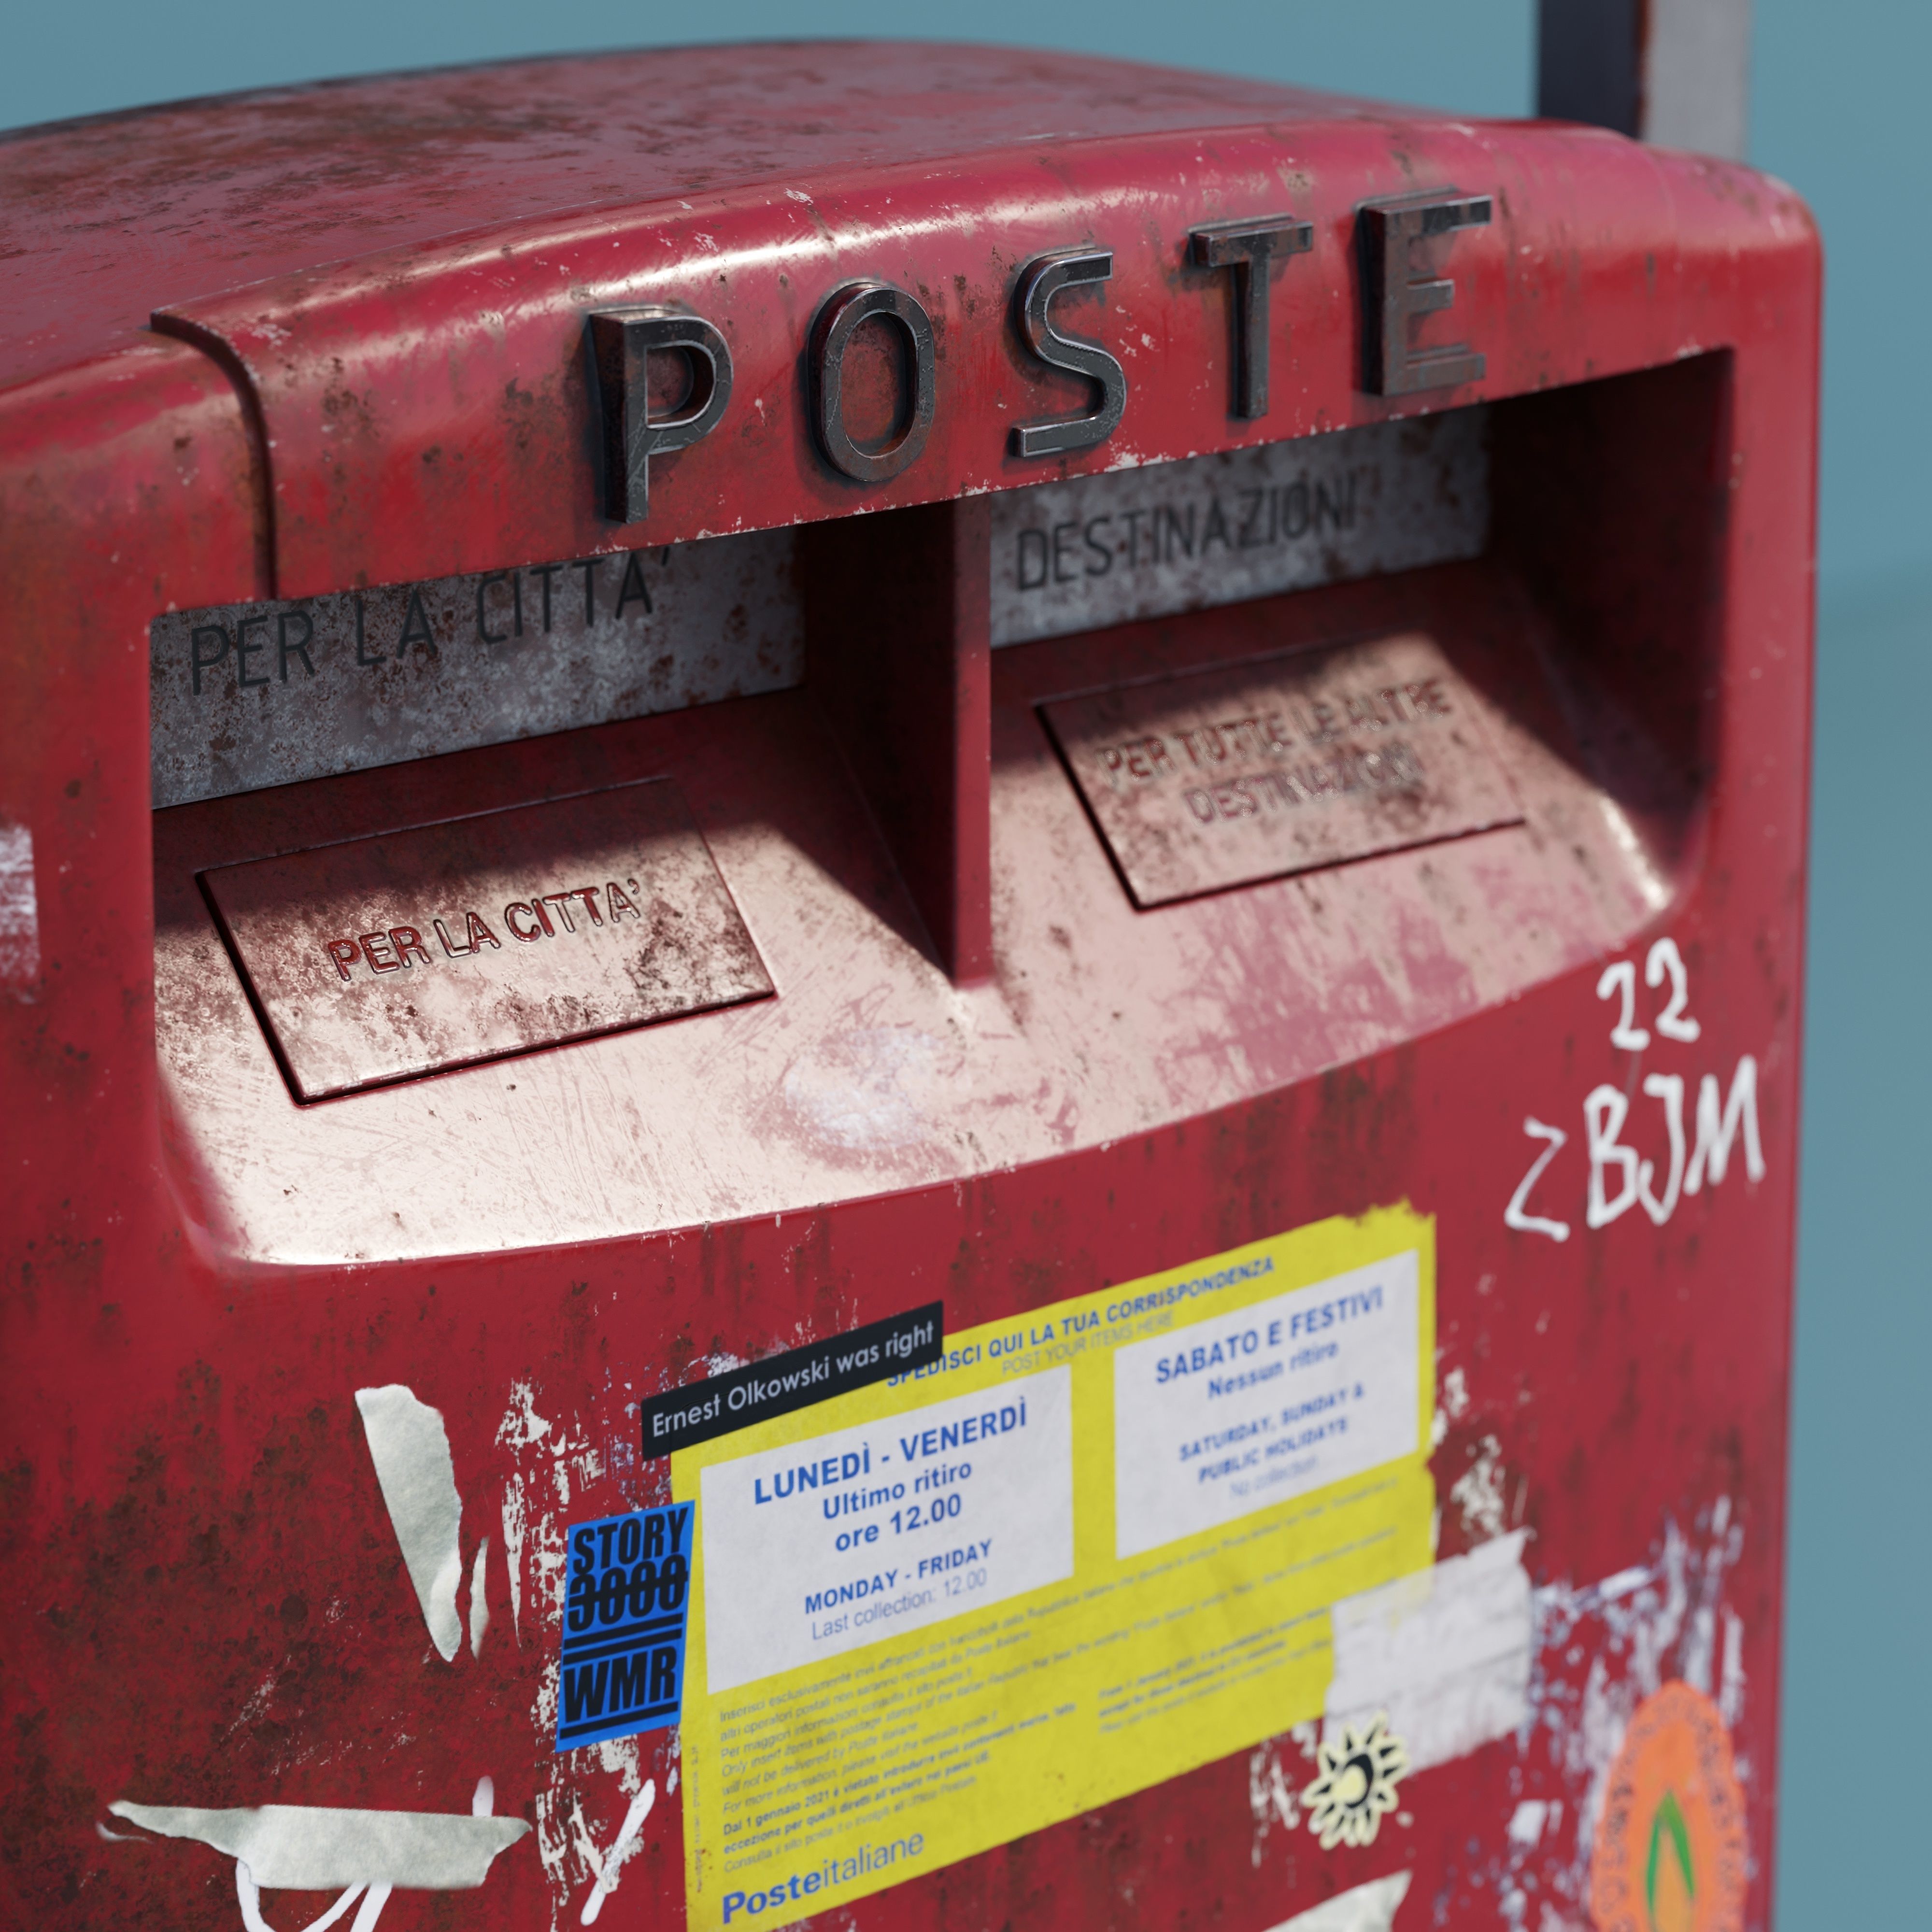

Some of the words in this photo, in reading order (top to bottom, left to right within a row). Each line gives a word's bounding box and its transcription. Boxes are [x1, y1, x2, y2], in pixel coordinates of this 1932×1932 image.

[587, 191, 1492, 524] POSTE
[1017, 471, 1357, 591] DESTINAZIONI
[192, 610, 316, 696] PER
[356, 590, 437, 666] LA
[1098, 739, 1176, 791] PER
[1176, 711, 1292, 765] TUTTE
[1293, 702, 1338, 744] LE
[1350, 679, 1451, 735] ALTRE
[1184, 741, 1424, 826] DESTINAZIONI
[327, 924, 431, 981] PER
[433, 911, 501, 958] LA
[989, 1335, 1023, 1358] QUI
[1031, 1323, 1054, 1347] LA
[1062, 1315, 1101, 1337] TUA
[1107, 1255, 1275, 1323] CORRISPONDENZA
[1001, 1351, 1042, 1377] POST
[1046, 1339, 1087, 1366] YOUR
[1091, 1326, 1133, 1352] ITEMS
[1136, 1311, 1175, 1338] HERE
[1156, 1329, 1259, 1384] SABATO
[1268, 1320, 1282, 1347] E
[1291, 1284, 1384, 1339] FESTIVI
[653, 1394, 721, 1437] Ernest
[728, 1356, 829, 1411] Olkowski
[836, 1345, 879, 1373] was
[884, 1321, 934, 1359] right
[1208, 1360, 1284, 1399] Nessun
[1290, 1341, 1339, 1371] ritiro
[754, 1442, 870, 1505] LUNEDÌ
[881, 1453, 891, 1464] -
[899, 1396, 1026, 1462] VENERDÌ
[1199, 1447, 1260, 1484] PUBLIC
[823, 1482, 906, 1520] Ultimo
[914, 1462, 973, 1496] ritiro
[836, 1524, 879, 1553] ore
[890, 1493, 961, 1535] 12.00
[573, 1506, 689, 1576] STORY
[805, 1569, 898, 1615] MONDAY
[918, 1538, 993, 1580] FRIDAY
[811, 1613, 849, 1641] Last
[853, 1586, 937, 1628] collection:
[943, 1567, 988, 1599] 12.00
[563, 1646, 677, 1724] WMR
[723, 1817, 742, 1836] Dal
[722, 1833, 925, 1925] Posteitaliane
